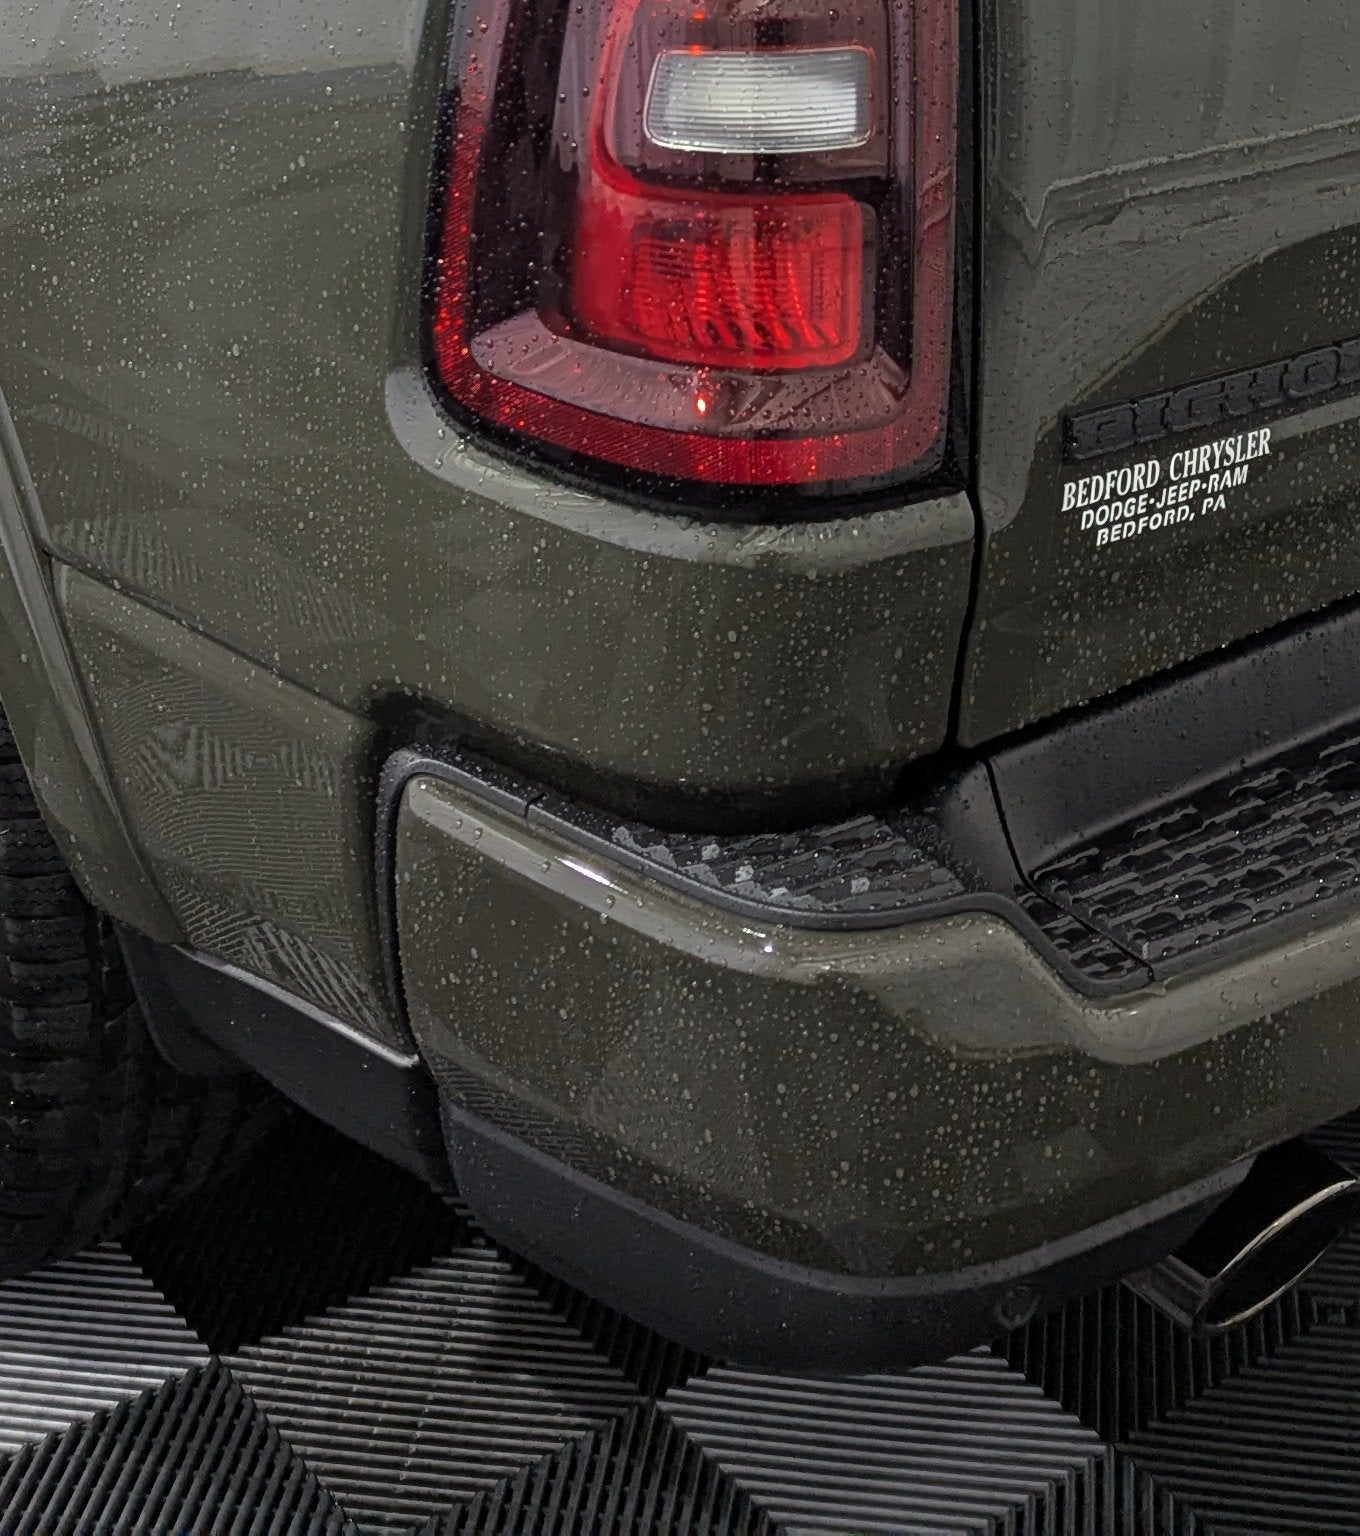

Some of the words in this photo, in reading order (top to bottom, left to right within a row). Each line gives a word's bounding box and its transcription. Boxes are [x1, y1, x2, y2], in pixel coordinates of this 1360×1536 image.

[1060, 459, 1161, 512] BEDFORD
[1169, 427, 1272, 482] CHRYSLER
[1095, 504, 1196, 547] BEDFORD,
[1201, 493, 1227, 515] PA
